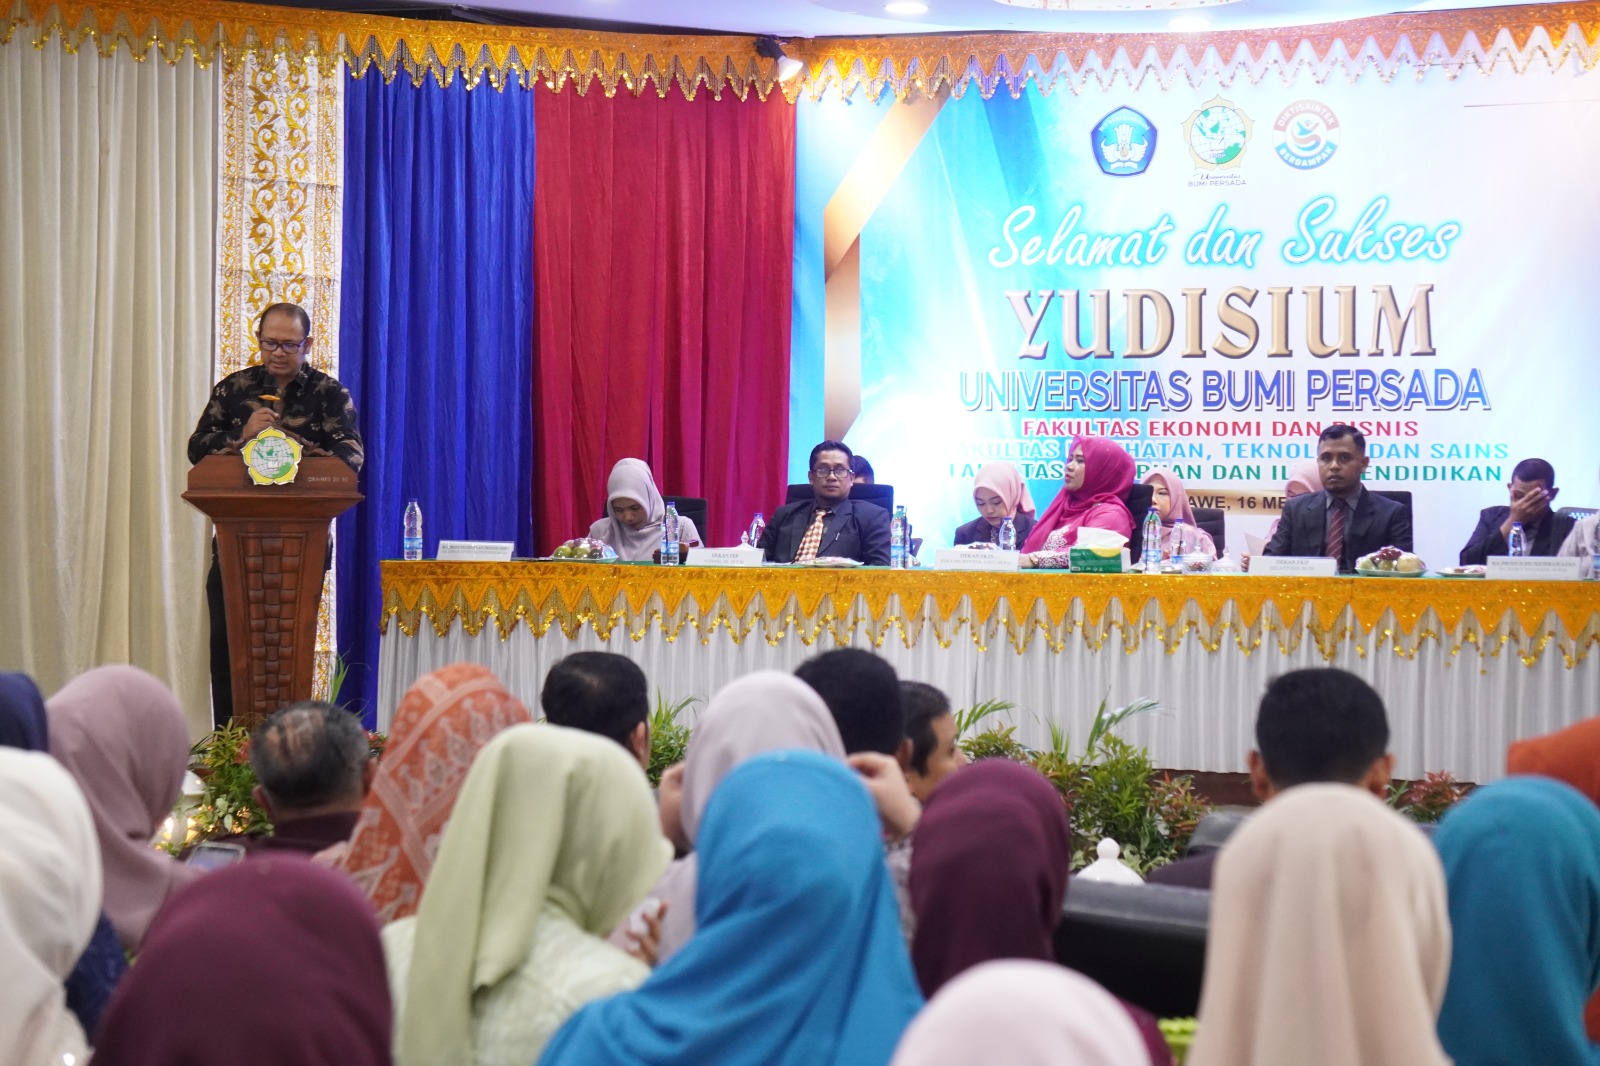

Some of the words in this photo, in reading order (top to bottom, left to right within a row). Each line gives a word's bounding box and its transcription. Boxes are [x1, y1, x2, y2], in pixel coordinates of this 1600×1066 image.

[1277, 103, 1336, 127] DIKTISAINTEK
[1279, 146, 1333, 167] BERDAMPAK
[988, 203, 1176, 268] Selamat
[1185, 203, 1262, 268] dan
[1282, 195, 1461, 264] Sukses
[1005, 284, 1437, 360] YUDISIUM
[959, 369, 1193, 412] UNIVERSITAS
[1201, 369, 1295, 412] BUMI
[1306, 368, 1491, 411] PERSADA
[1023, 421, 1140, 437] FAKULTAS
[1149, 421, 1261, 437] EKONOMI
[1272, 421, 1322, 437] DAN
[1333, 421, 1419, 437] SNIS
[1221, 443, 1316, 459] TEKNOL
[1369, 443, 1420, 459] DAN
[1430, 443, 1509, 459] SAINS
[1212, 464, 1262, 480] DAN
[1360, 465, 1502, 481] ENDIDIKAN
[1237, 496, 1257, 509] 16
